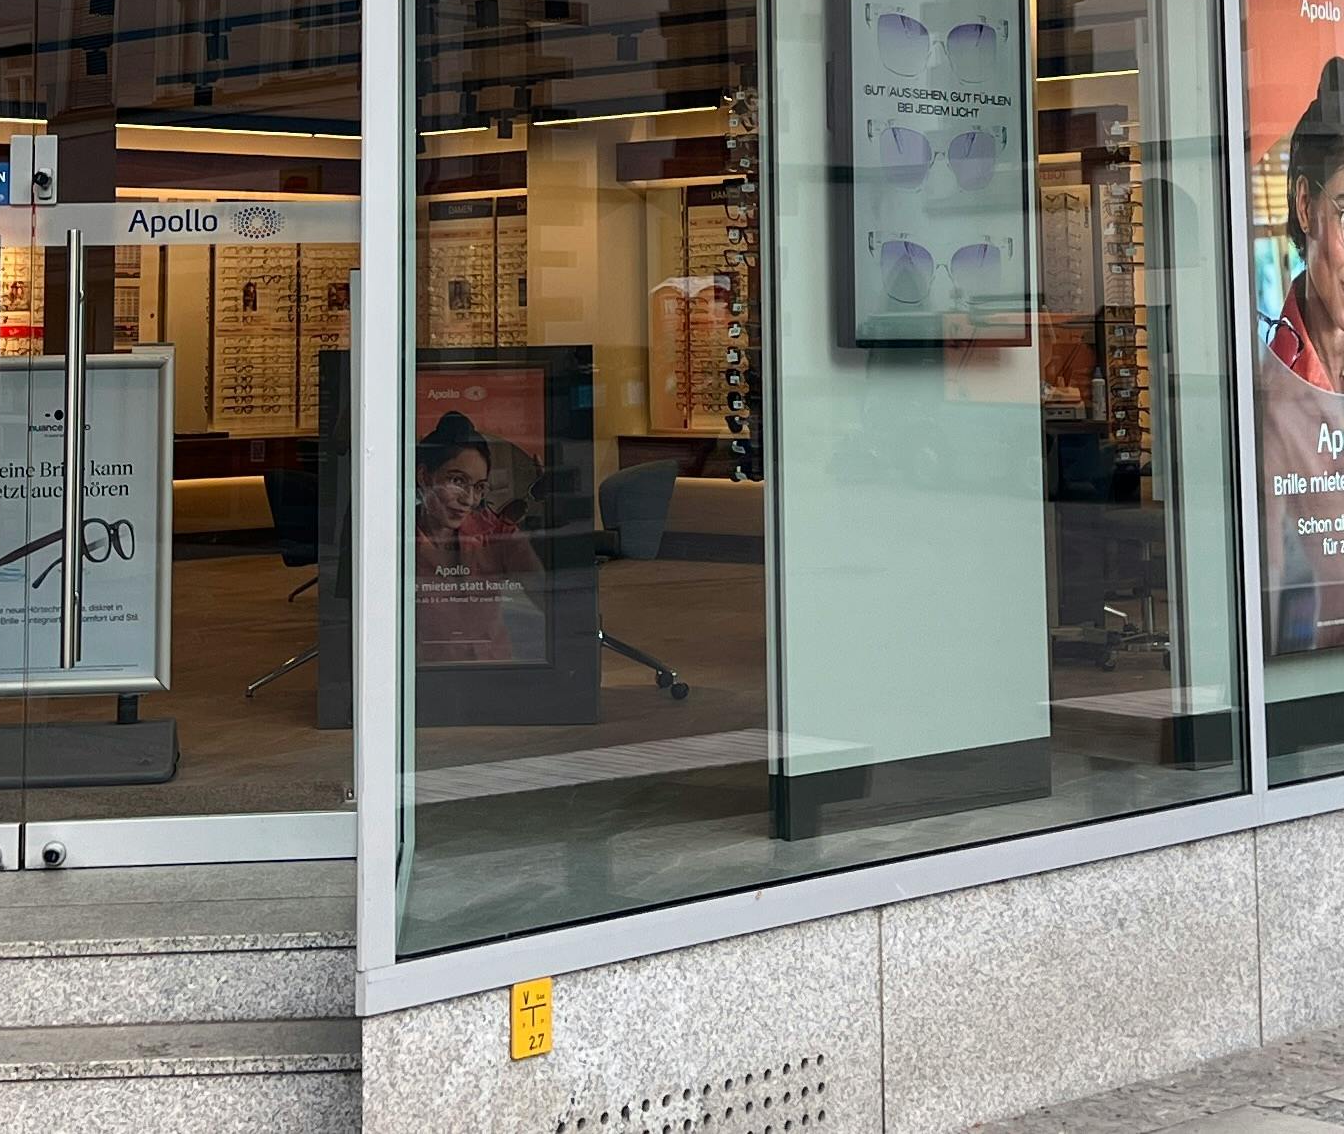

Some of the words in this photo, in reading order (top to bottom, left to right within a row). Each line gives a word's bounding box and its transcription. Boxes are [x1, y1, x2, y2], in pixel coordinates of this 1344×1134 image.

[864, 85, 886, 96] GUT
[950, 91, 972, 102] GUT
[973, 91, 1012, 106] FÜHLEN
[897, 102, 913, 113] BEI
[915, 104, 950, 116] JEDEM
[951, 107, 980, 118] LICHT
[127, 208, 218, 238] Apollo
[427, 387, 461, 400] Apollo
[90, 460, 134, 476] kann
[1273, 473, 1307, 496] Brille
[31, 486, 63, 499] auc
[1297, 516, 1332, 535] Schon
[1323, 537, 1338, 555] für
[435, 565, 470, 578] Apollo
[421, 581, 458, 593] mieten
[460, 580, 484, 592] statt
[485, 579, 524, 591] kaufen.
[115, 603, 123, 611] in
[81, 615, 107, 623] omfort
[109, 613, 125, 622] und
[523, 990, 529, 1005] V
